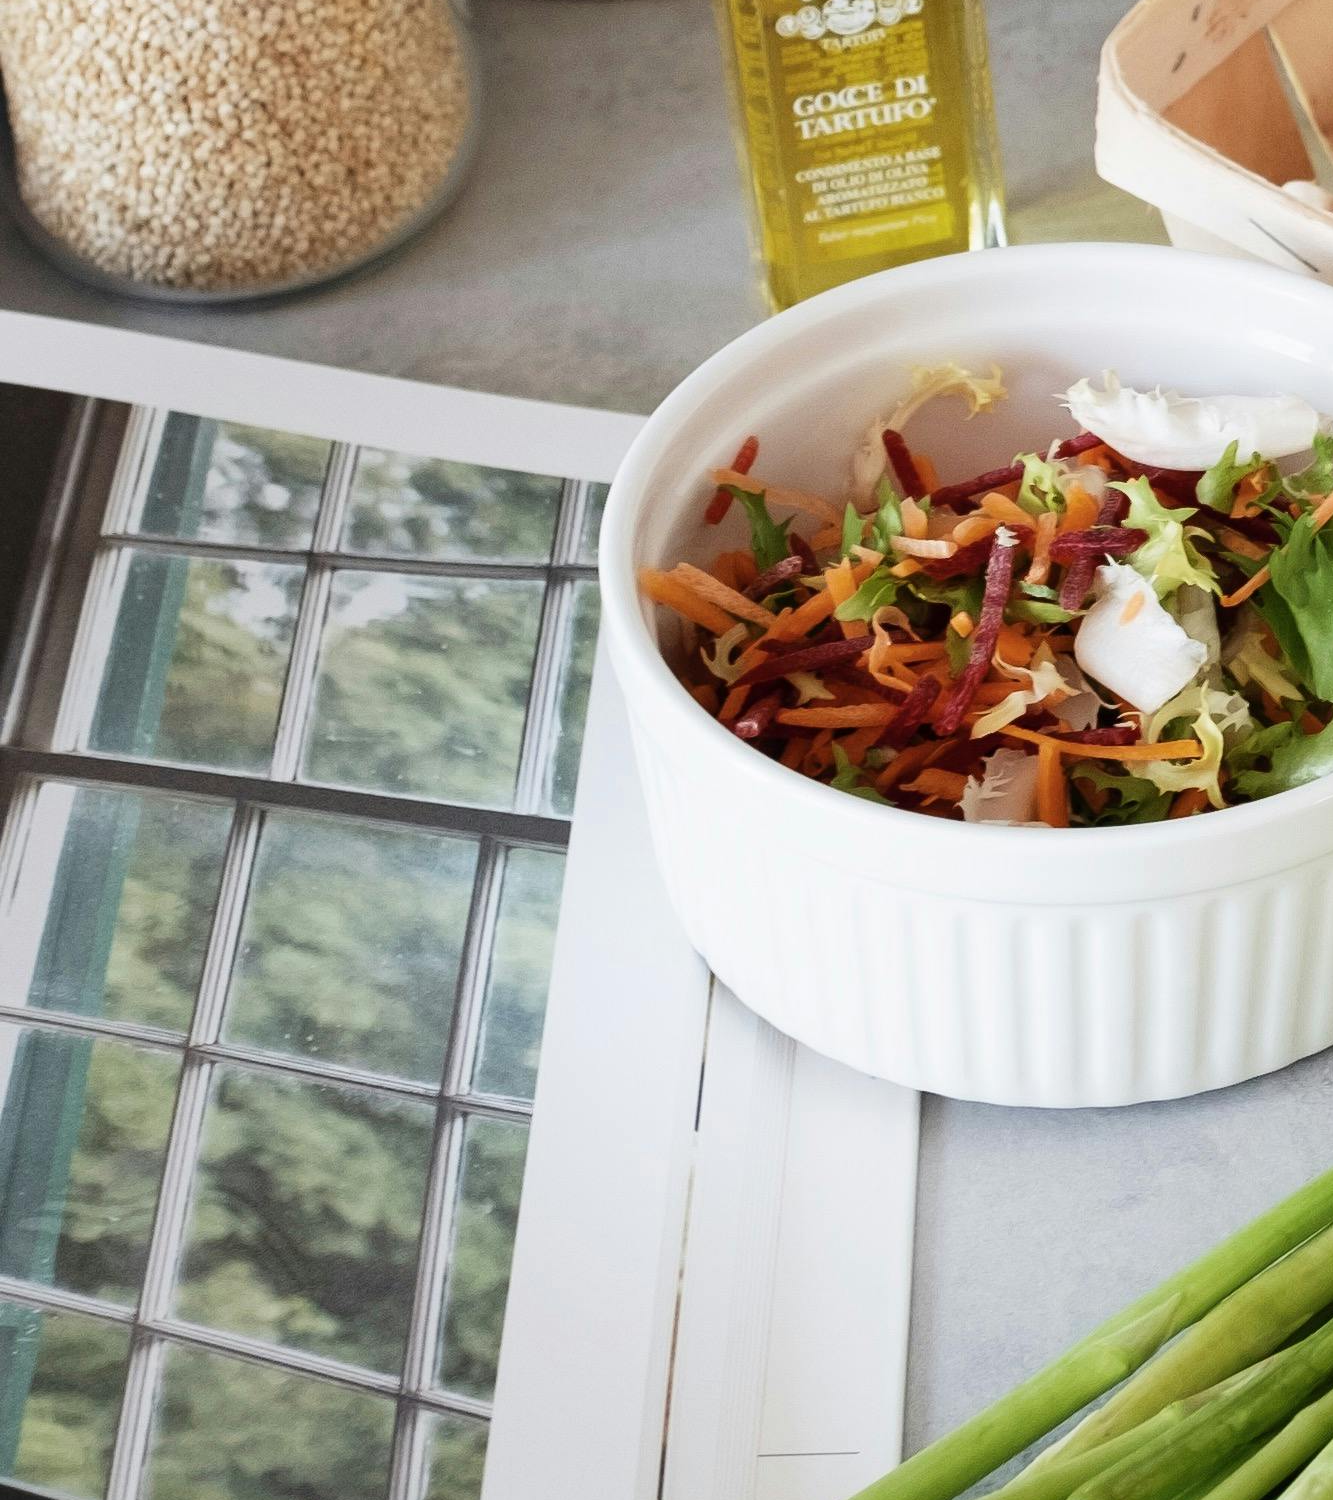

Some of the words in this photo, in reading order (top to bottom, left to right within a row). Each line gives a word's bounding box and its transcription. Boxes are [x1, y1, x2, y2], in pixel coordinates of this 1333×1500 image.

[792, 82, 883, 118] GOCCE
[895, 74, 928, 98] DI
[793, 99, 933, 140] TARTUFO
